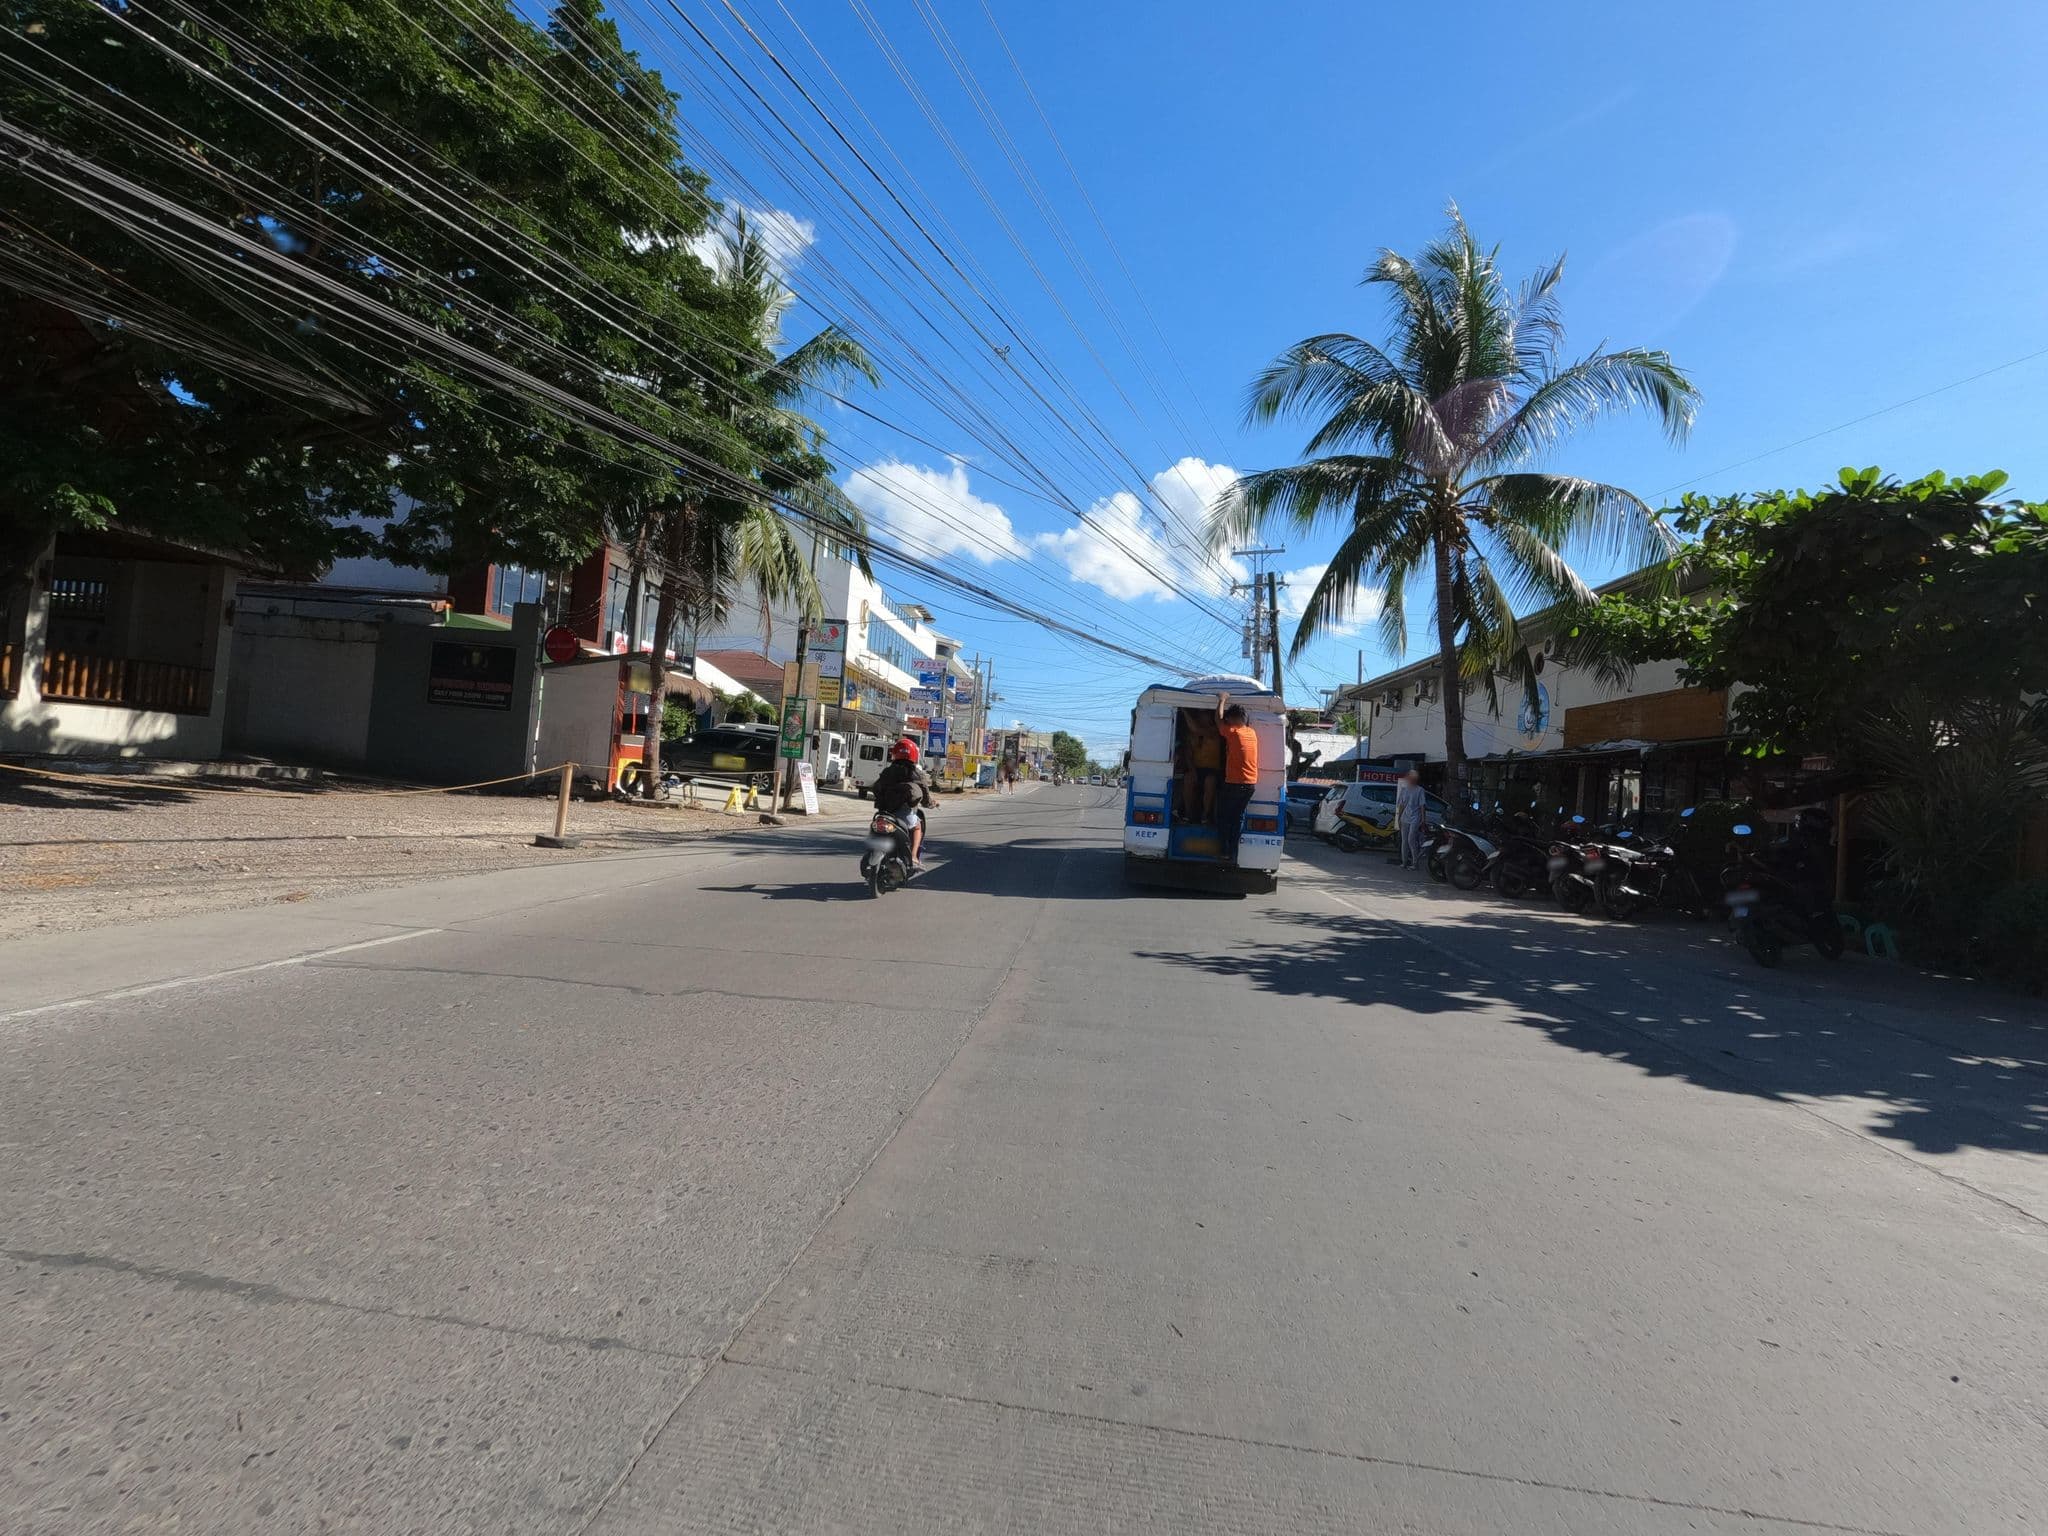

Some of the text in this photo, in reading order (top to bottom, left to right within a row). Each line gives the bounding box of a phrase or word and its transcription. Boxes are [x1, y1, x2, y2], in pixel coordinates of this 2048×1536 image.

[1363, 772, 1398, 782] HOTEL
[1135, 830, 1157, 838] KEEP
[1240, 837, 1281, 846] DNCE
